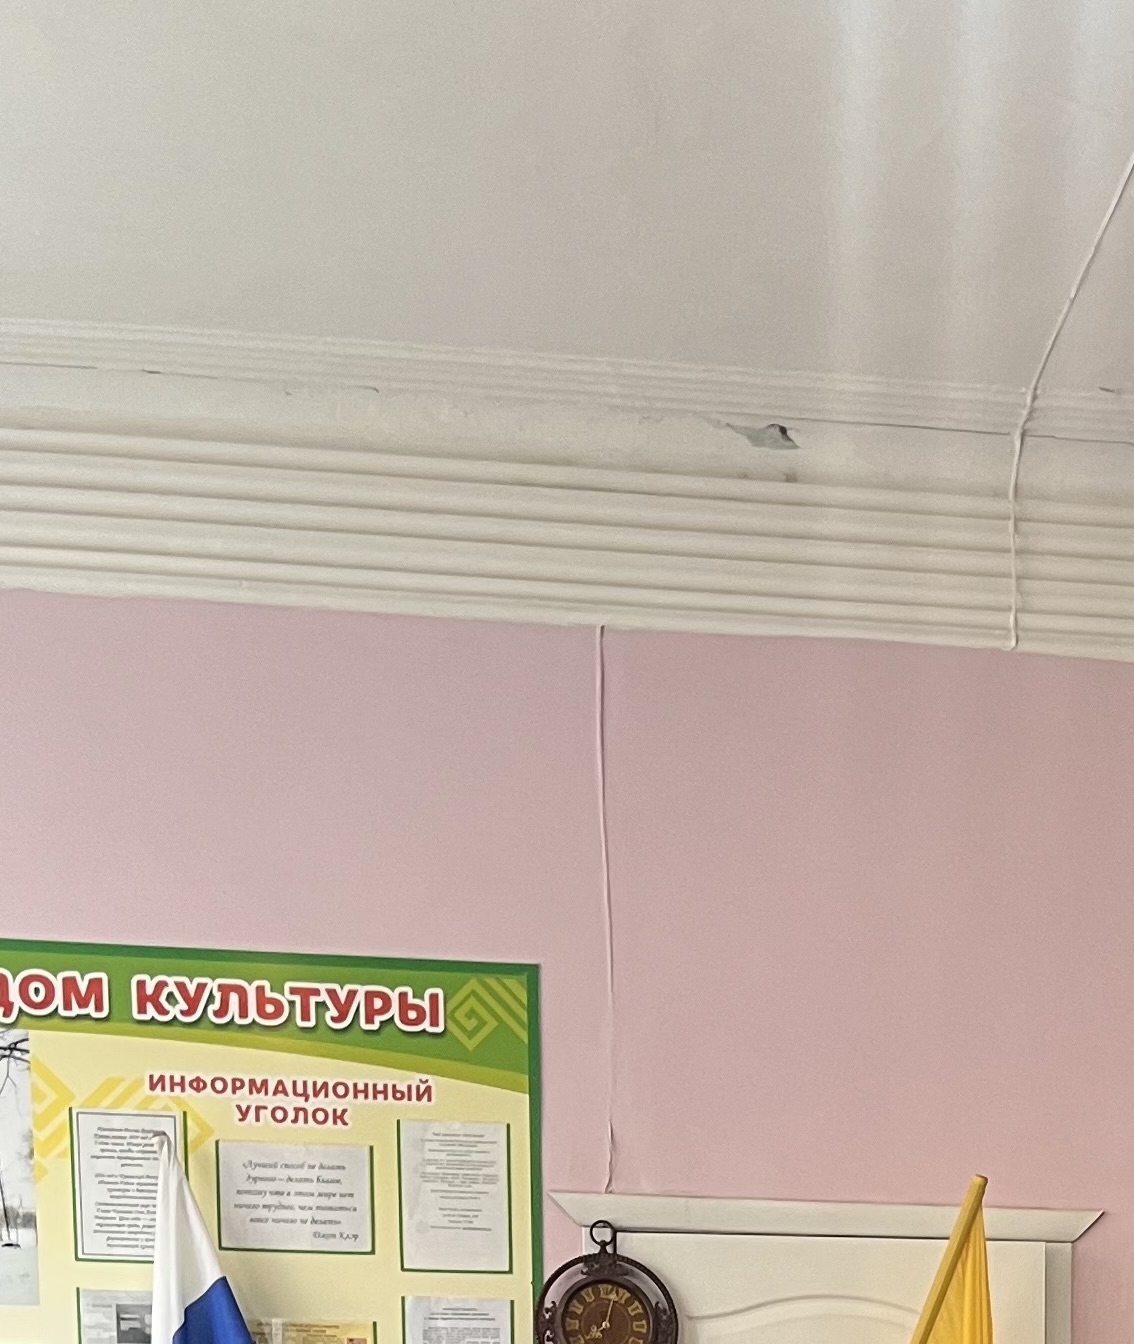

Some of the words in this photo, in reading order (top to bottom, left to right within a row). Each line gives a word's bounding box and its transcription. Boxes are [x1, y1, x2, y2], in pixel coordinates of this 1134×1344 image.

[135, 979, 441, 1029] КУЛЬТУРЫ
[147, 1073, 433, 1104] ИНФОРМАЦИОННЫЙ
[236, 1104, 350, 1127] УГОЛОК
